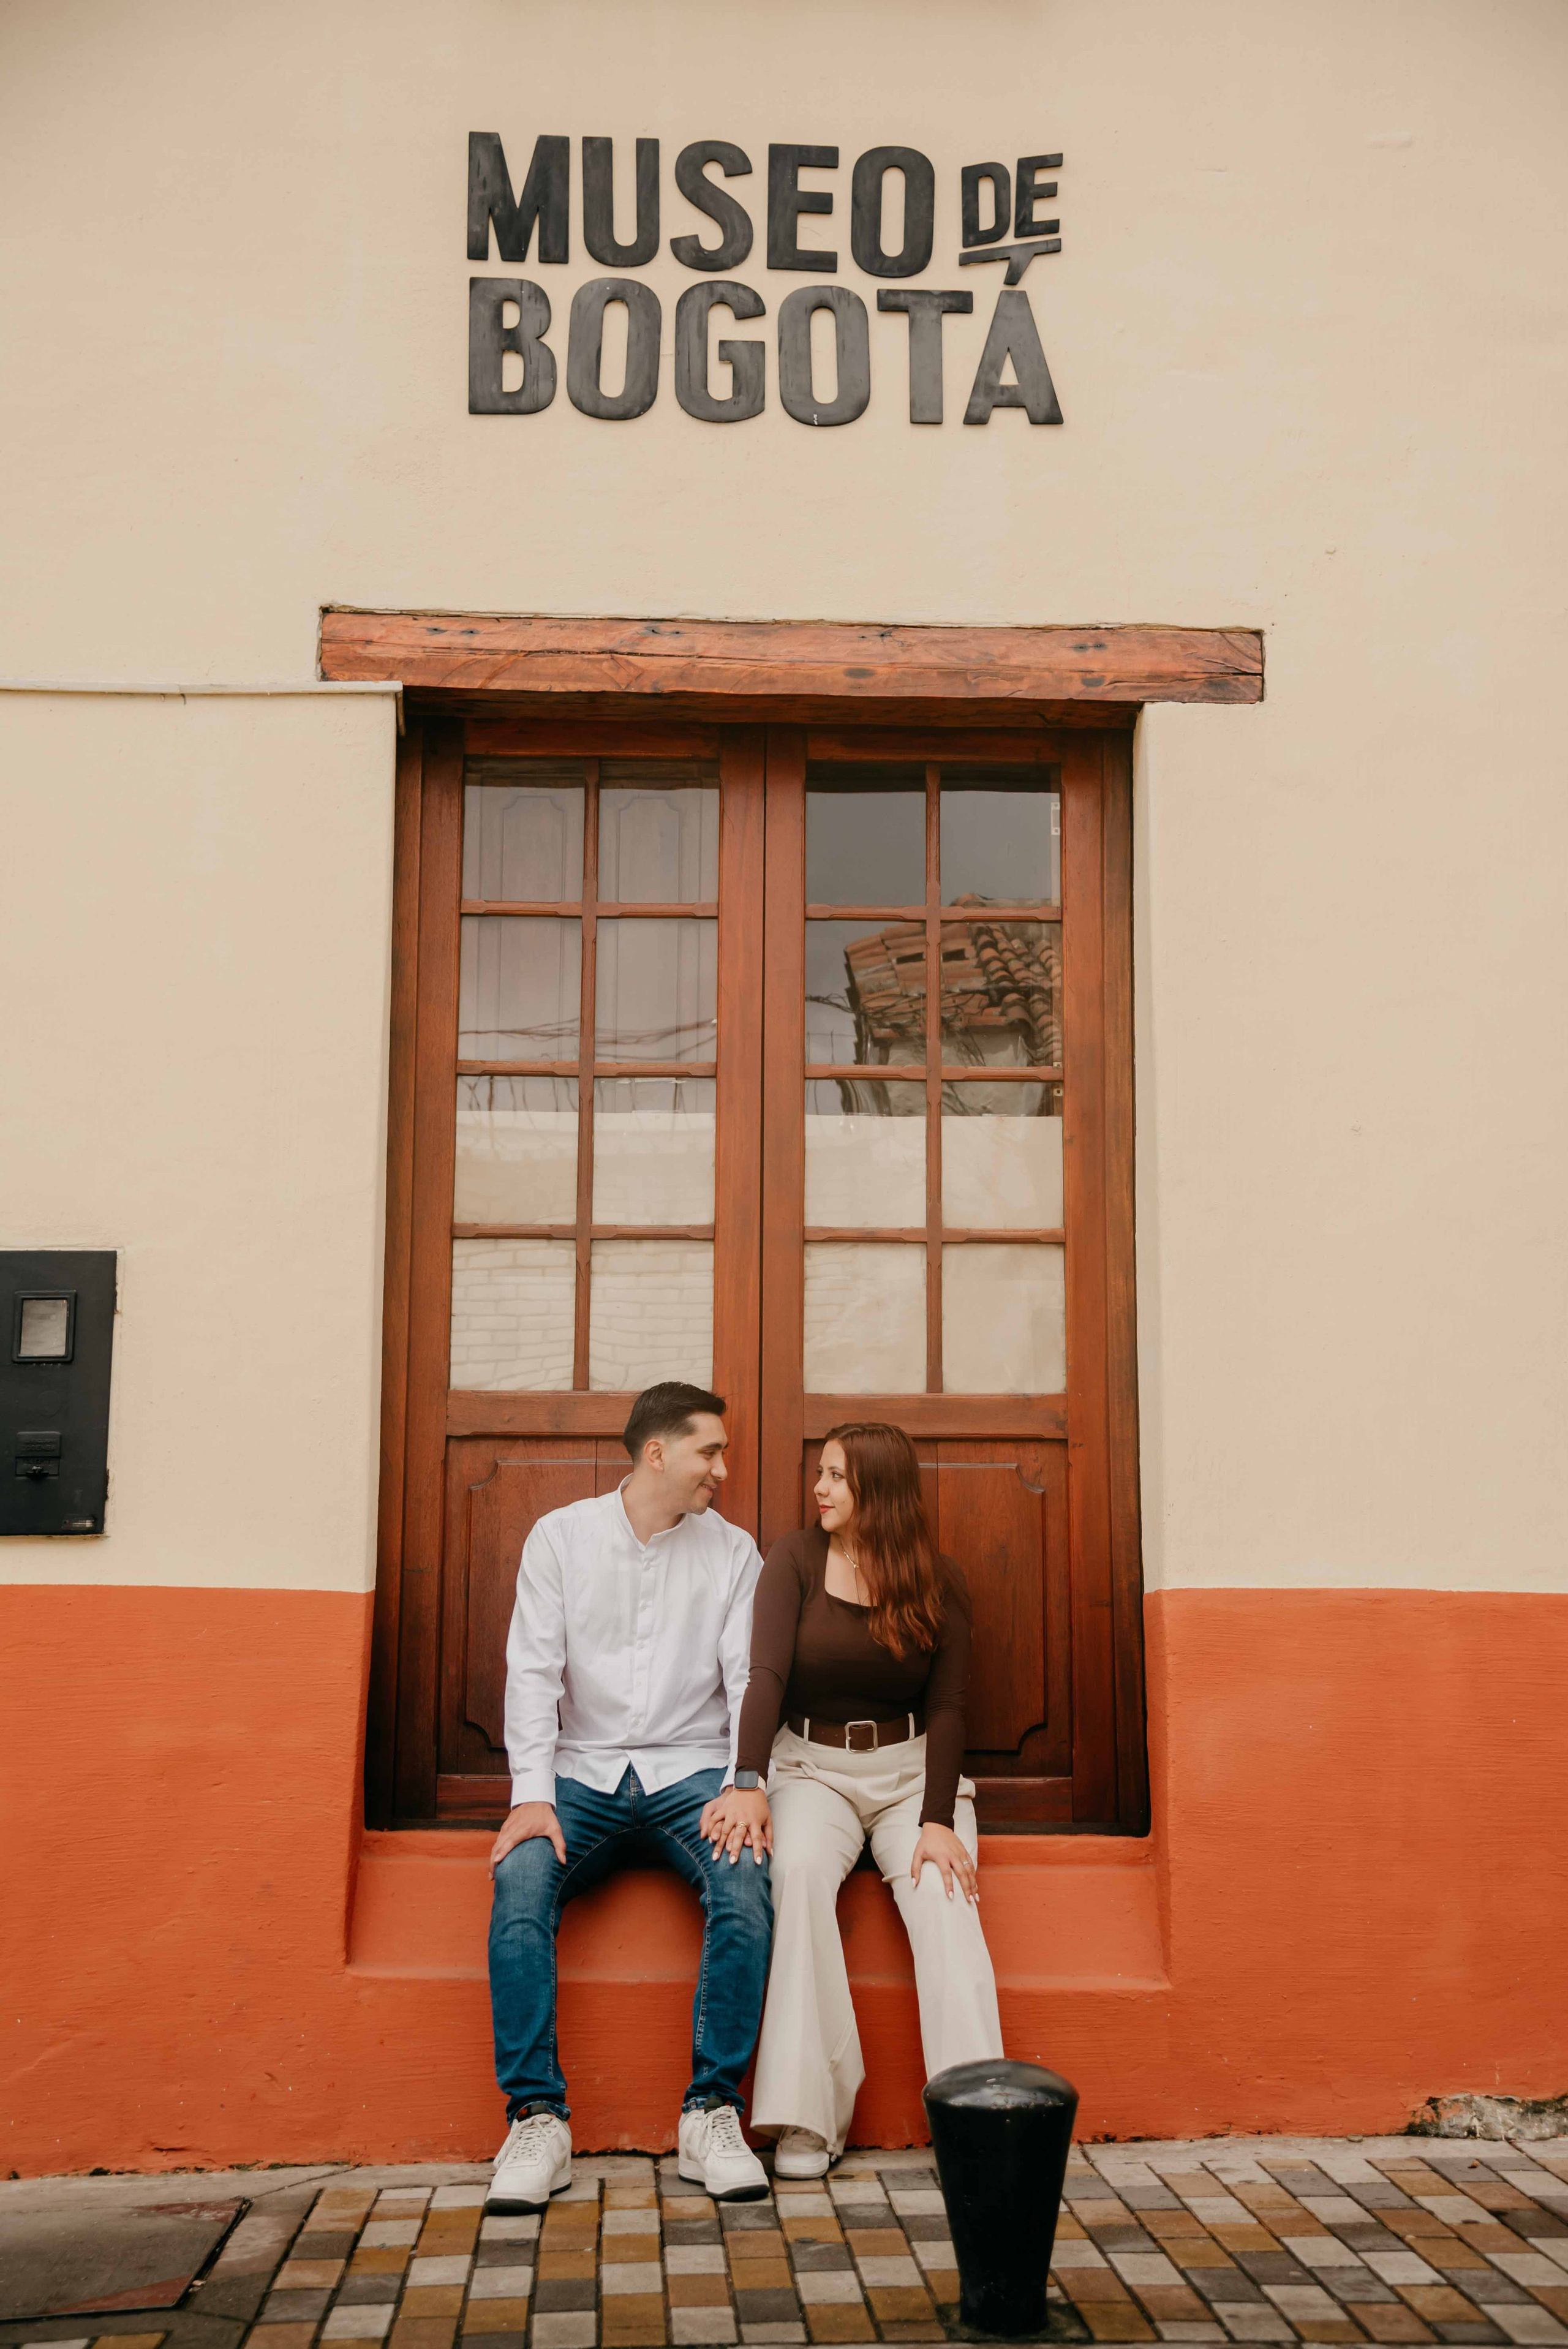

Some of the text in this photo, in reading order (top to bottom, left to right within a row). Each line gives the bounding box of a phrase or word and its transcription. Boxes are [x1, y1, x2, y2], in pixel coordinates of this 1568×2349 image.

[467, 131, 1063, 279] MUSEO DE
[468, 239, 1064, 427] BOGOTÁ
